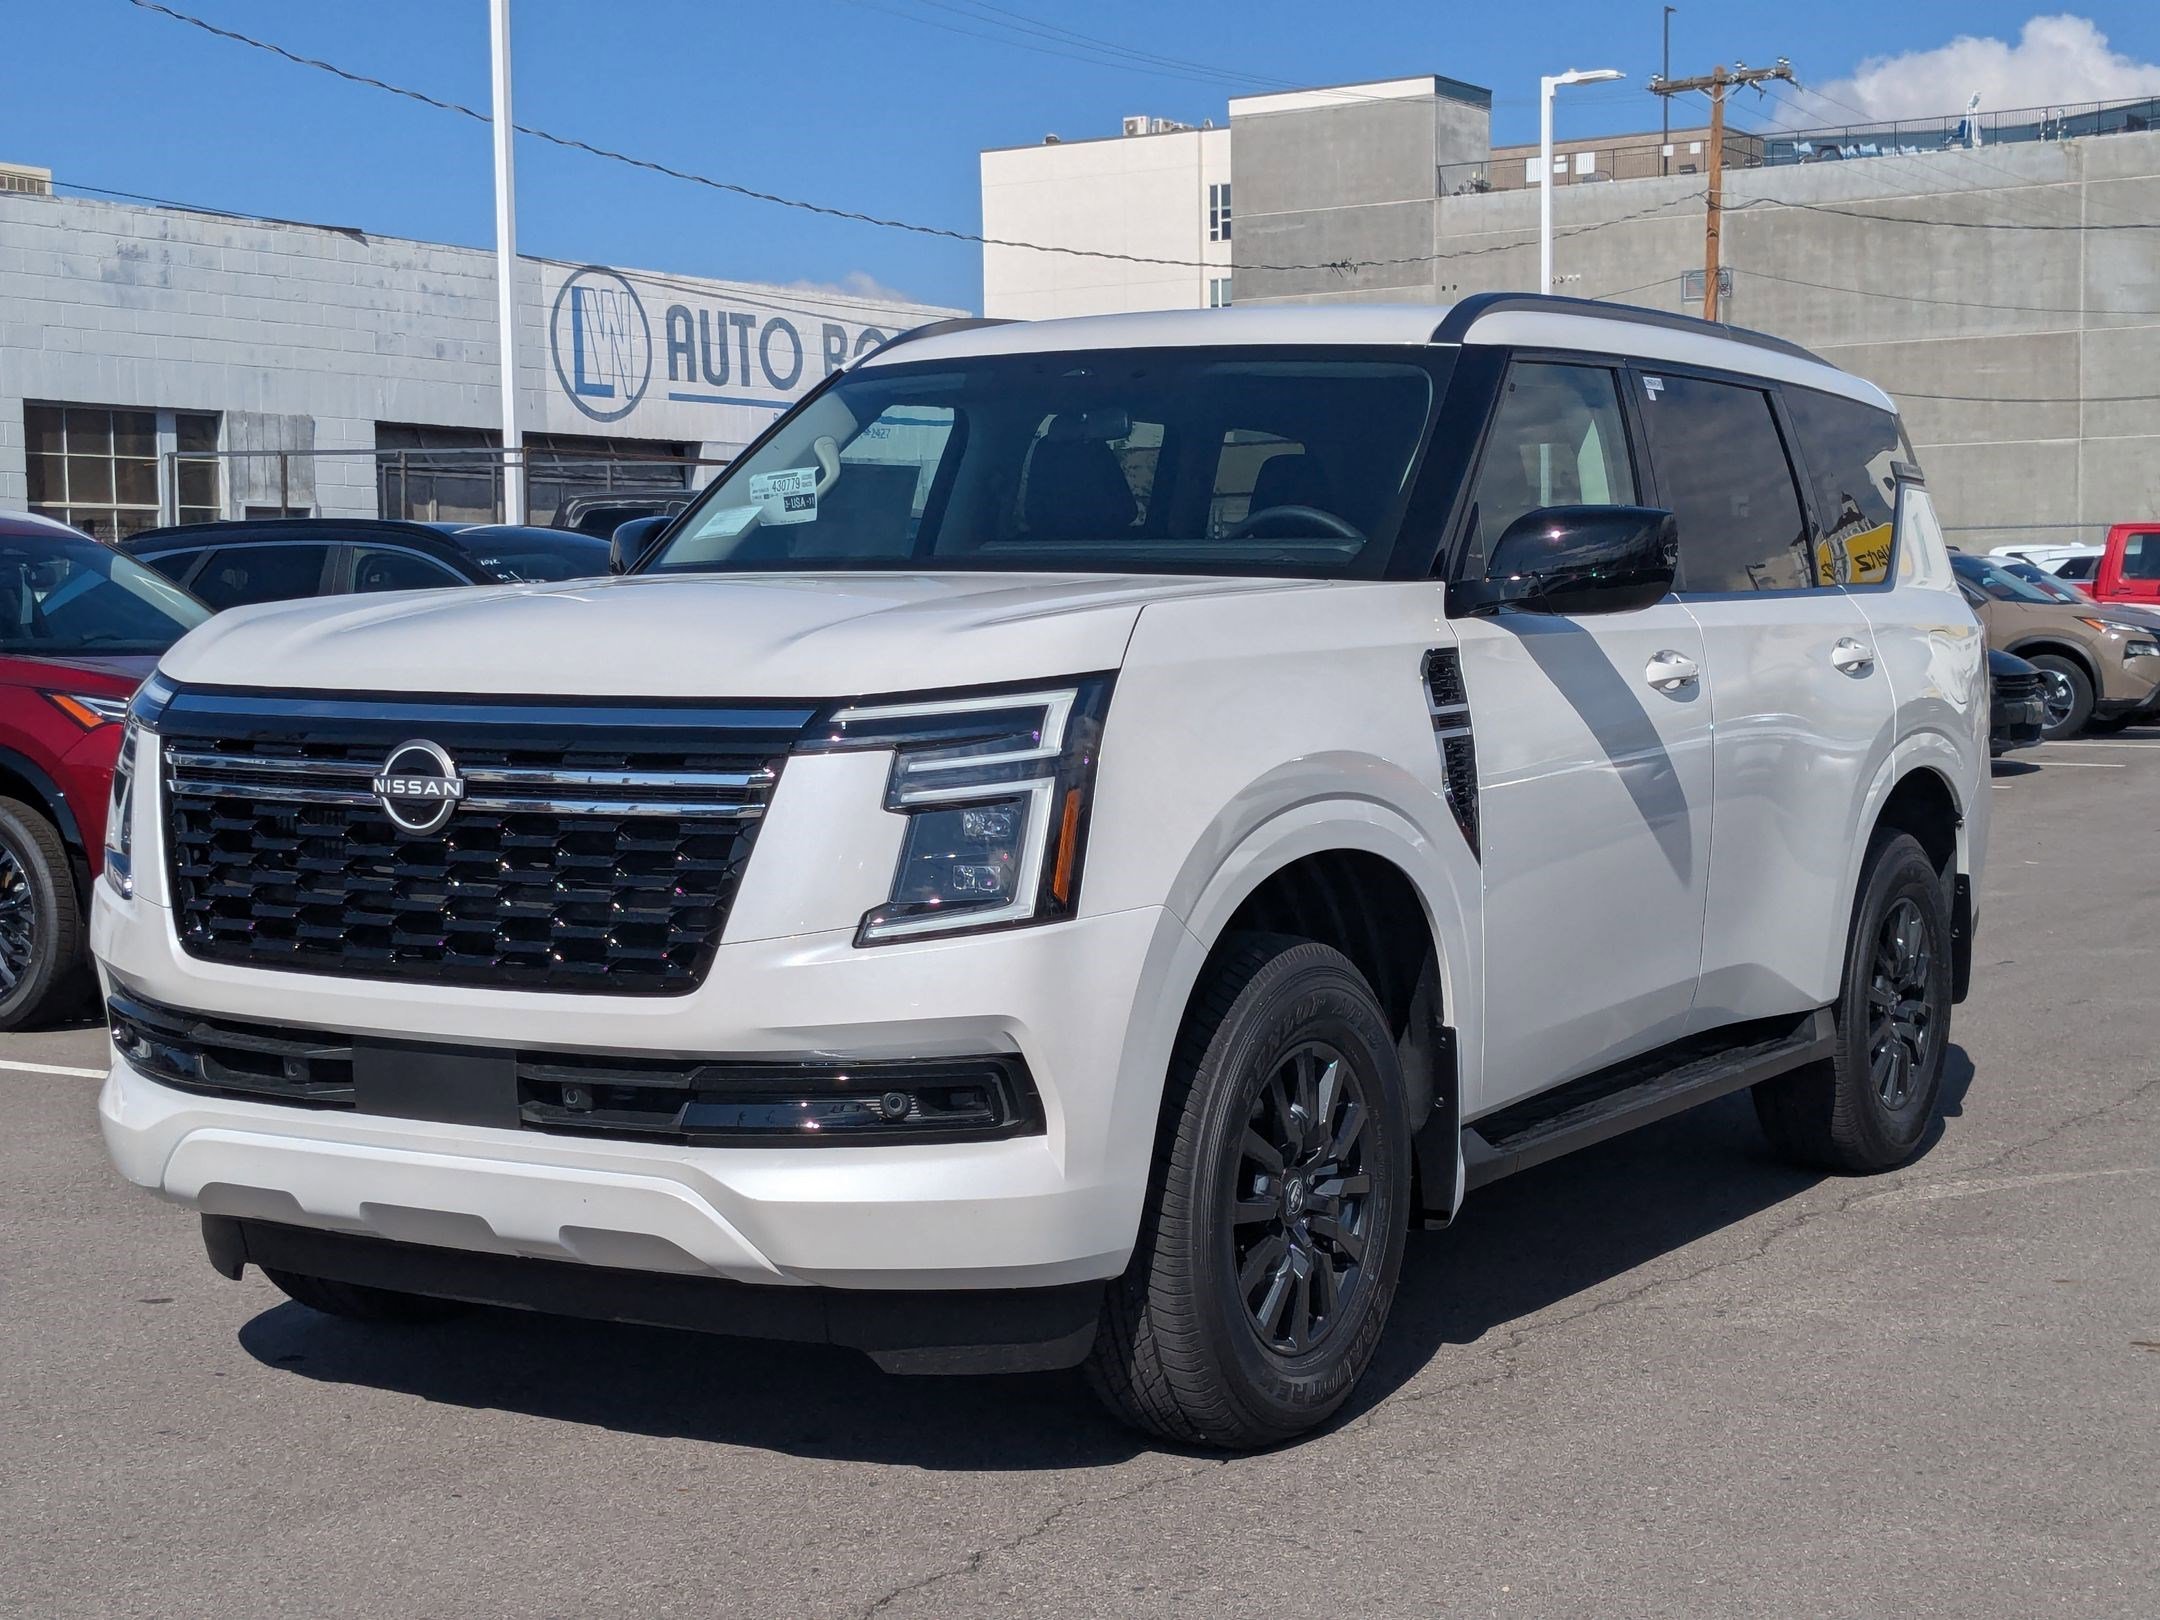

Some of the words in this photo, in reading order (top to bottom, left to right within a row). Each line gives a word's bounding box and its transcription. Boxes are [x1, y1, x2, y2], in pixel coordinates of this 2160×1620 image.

[666, 304, 804, 391] AUTO
[822, 323, 908, 378] BO
[771, 477, 801, 493] 430779
[373, 778, 461, 796] NISSAN
